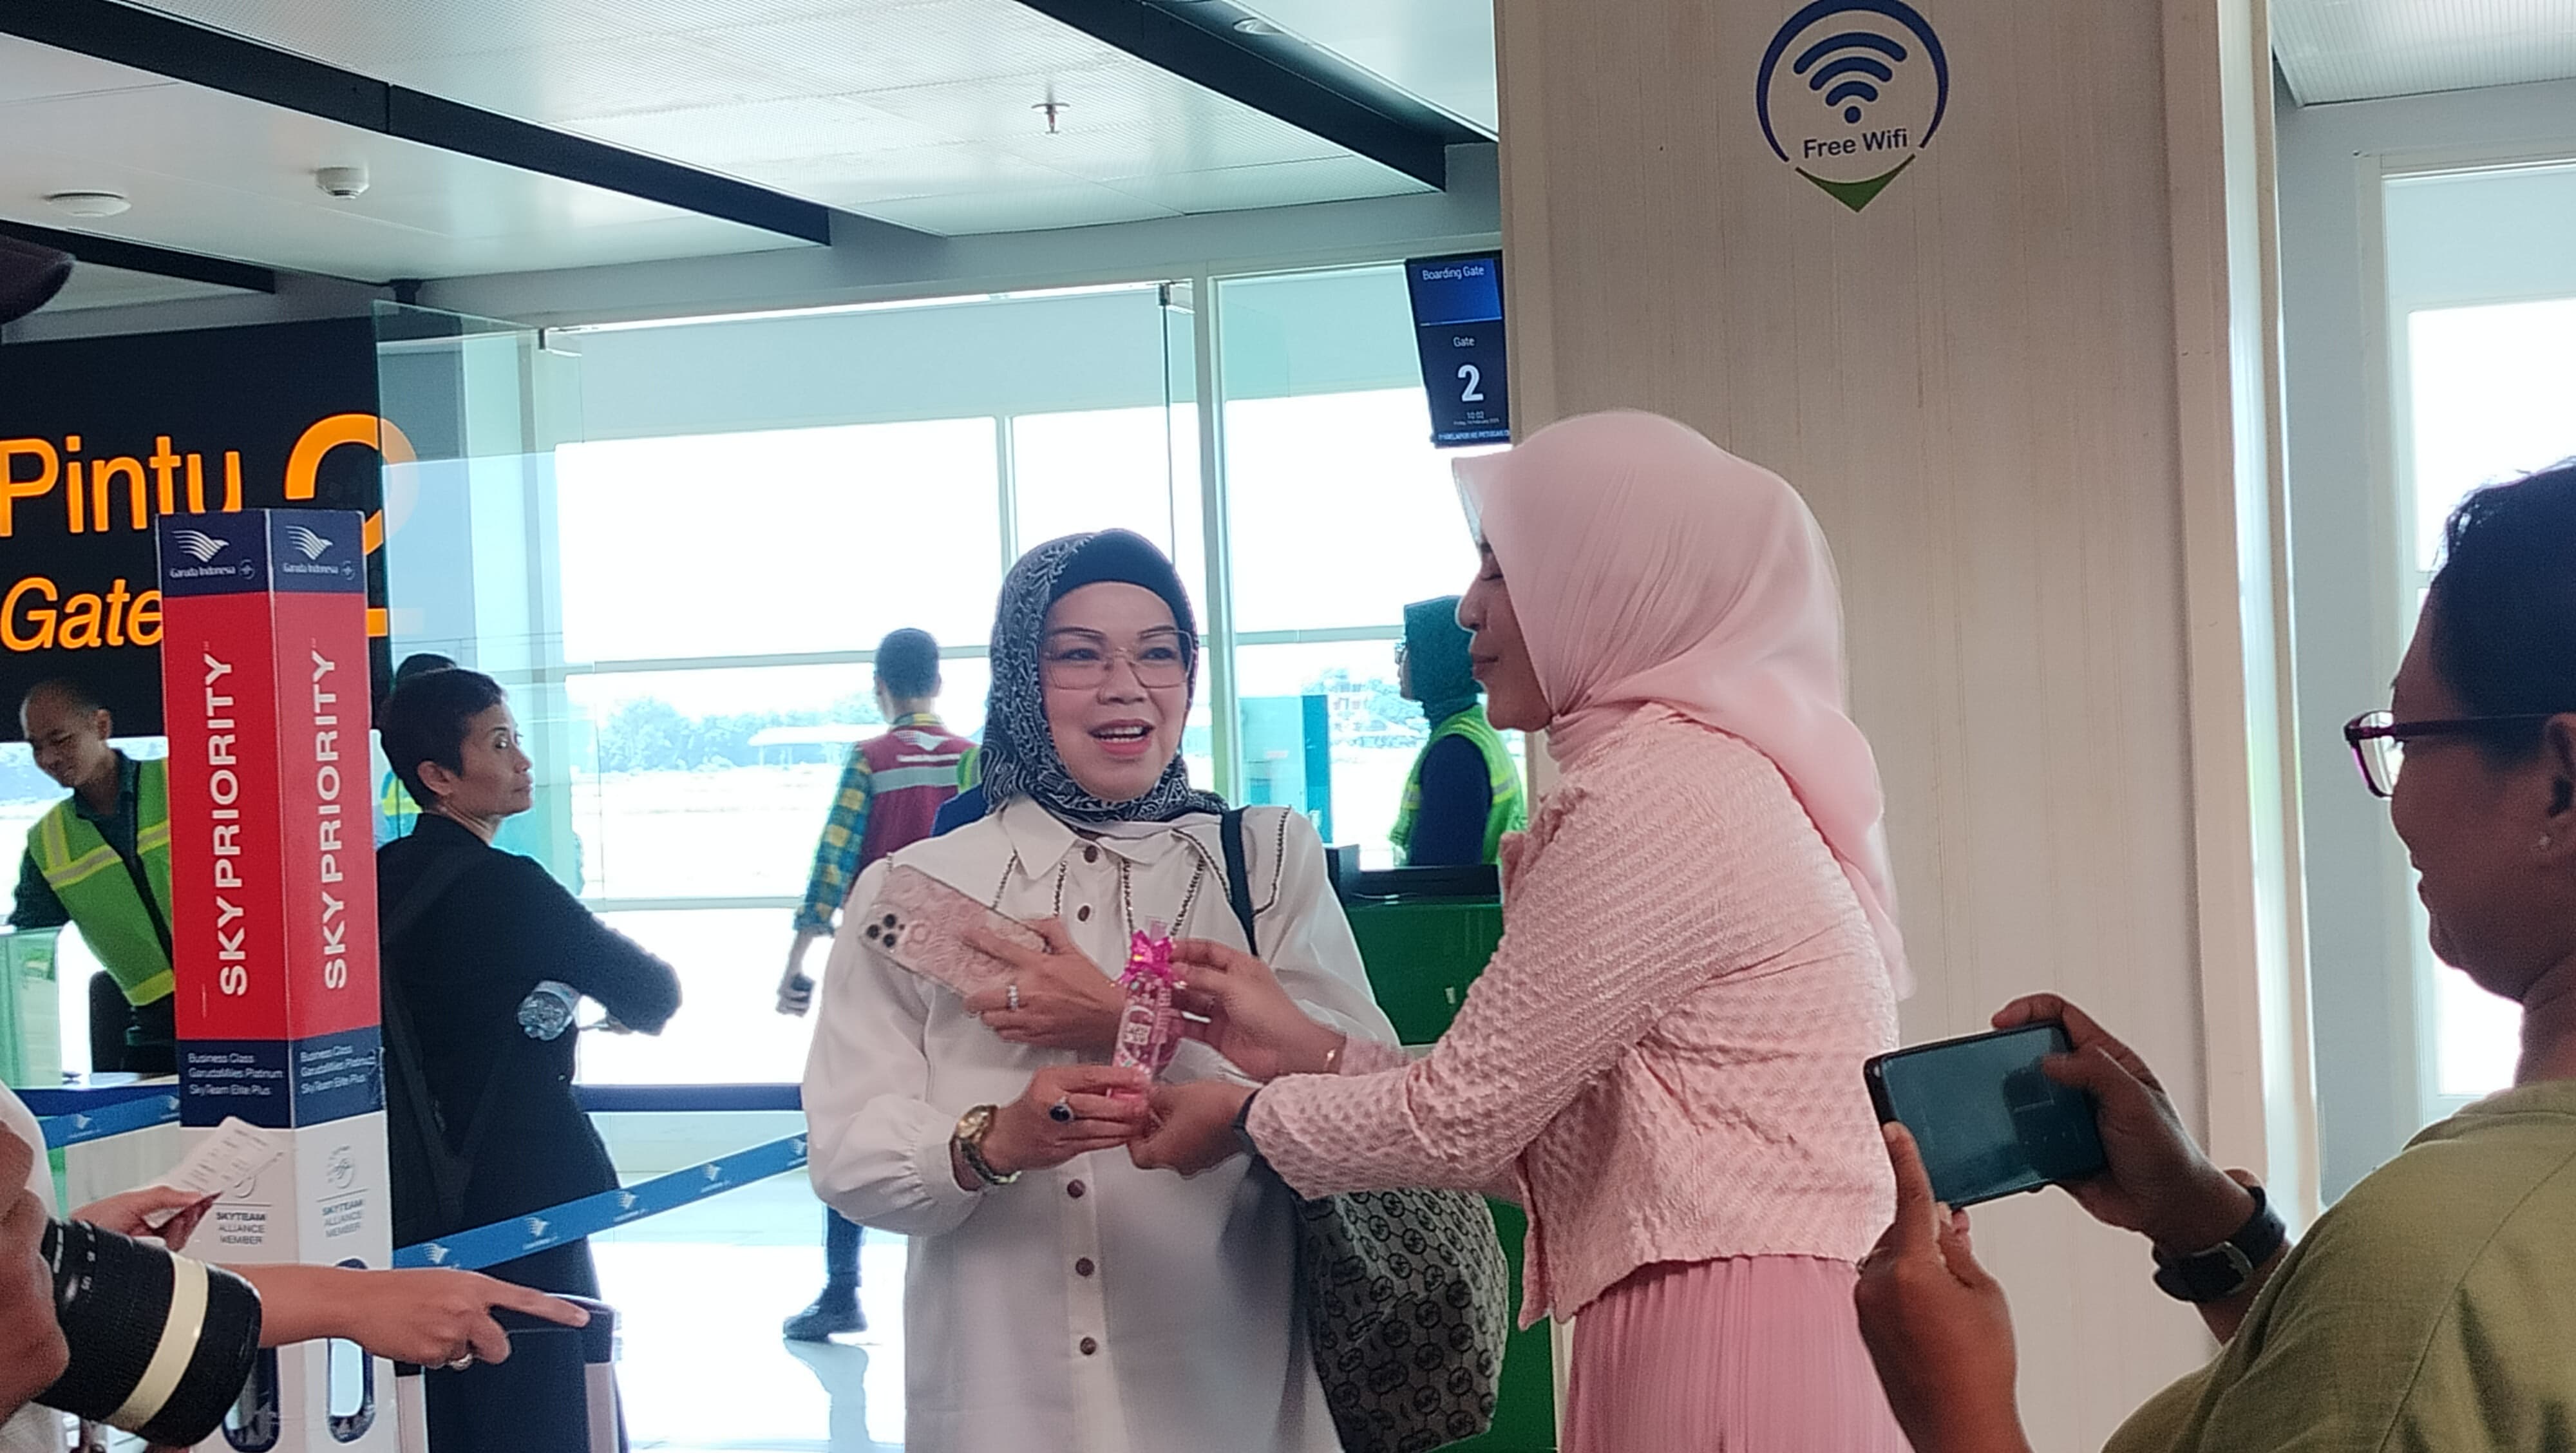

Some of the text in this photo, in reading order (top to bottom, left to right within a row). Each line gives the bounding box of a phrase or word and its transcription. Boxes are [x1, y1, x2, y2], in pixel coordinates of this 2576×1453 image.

[1803, 129, 1908, 159] Free Wifi
[1422, 265, 1484, 280] Boarding Gate
[1453, 336, 1475, 347] Gate
[1457, 364, 1484, 402] 2
[0, 435, 243, 537] Pintu
[1, 576, 163, 652] Gate
[187, 1052, 255, 1063] Business Class
[245, 1067, 283, 1078] Platinum
[189, 1083, 229, 1096] SkyTeam
[251, 1084, 271, 1096] Plus
[216, 1211, 266, 1221] SKYTEAM
[218, 1224, 266, 1234] ALLIANCE
